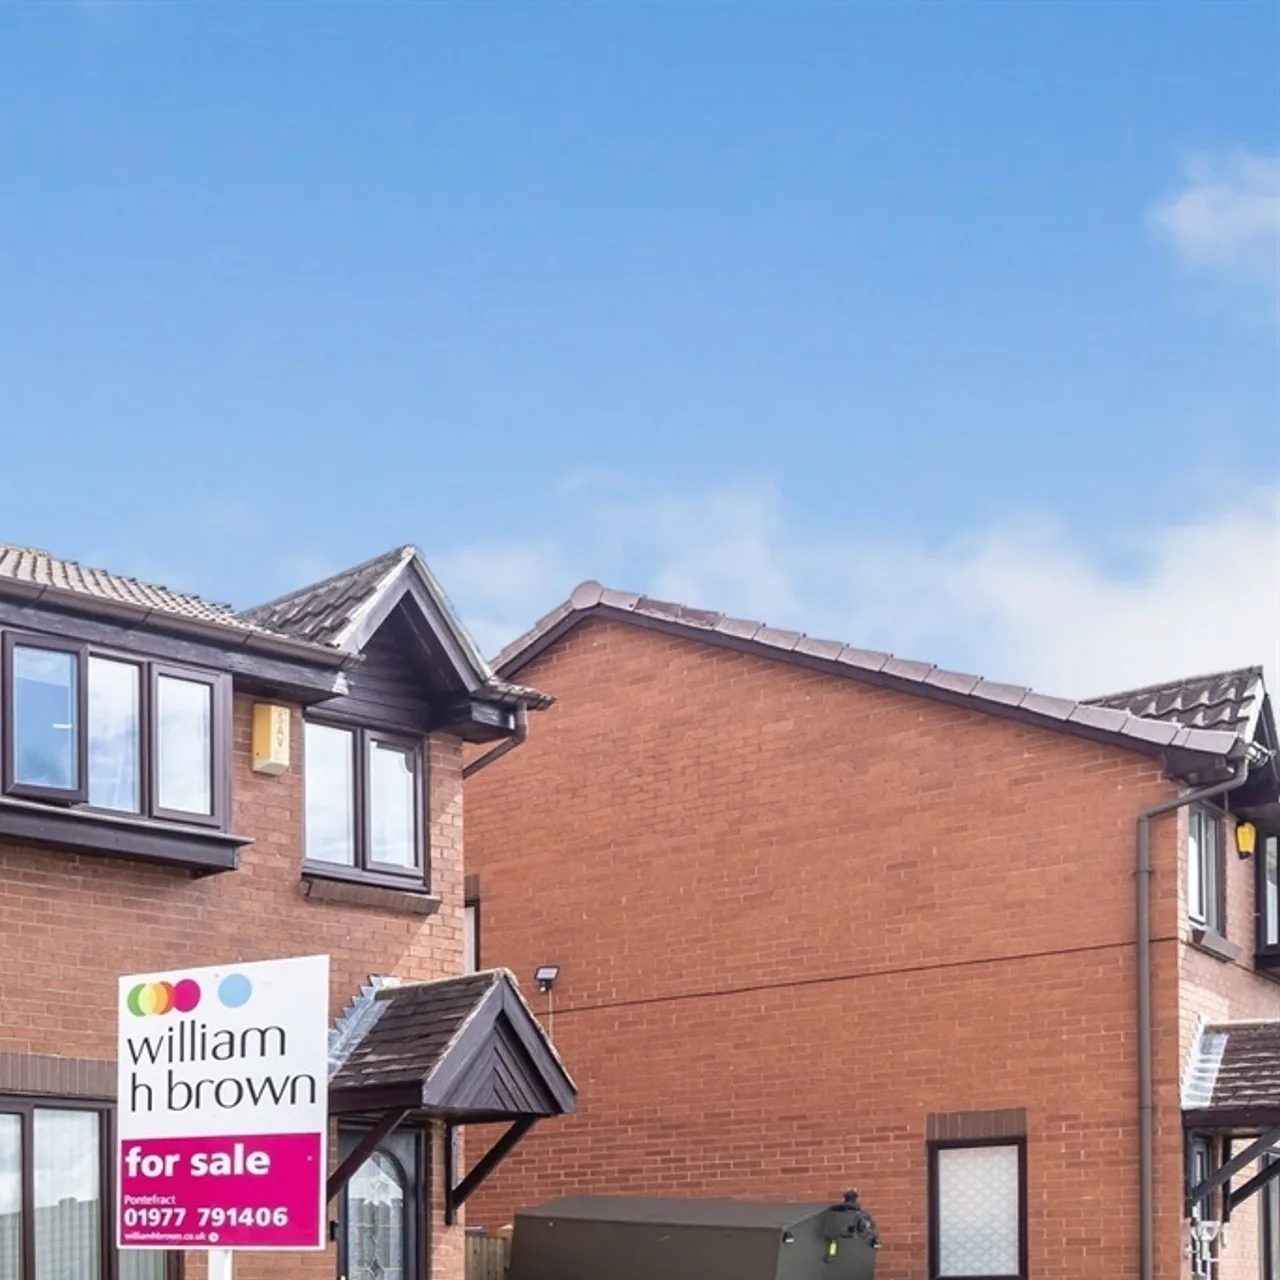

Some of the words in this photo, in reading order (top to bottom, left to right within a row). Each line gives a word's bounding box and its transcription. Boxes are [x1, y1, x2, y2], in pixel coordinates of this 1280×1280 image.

[127, 1019, 286, 1066] william
[130, 1071, 153, 1113] h
[167, 1069, 316, 1112] brown
[125, 1146, 180, 1178] for
[190, 1143, 271, 1177] sale
[123, 1194, 177, 1205] Pontefract
[123, 1208, 187, 1227] 01977
[197, 1207, 289, 1227] 791406
[124, 1230, 207, 1241] williamhbrown.co.uk
